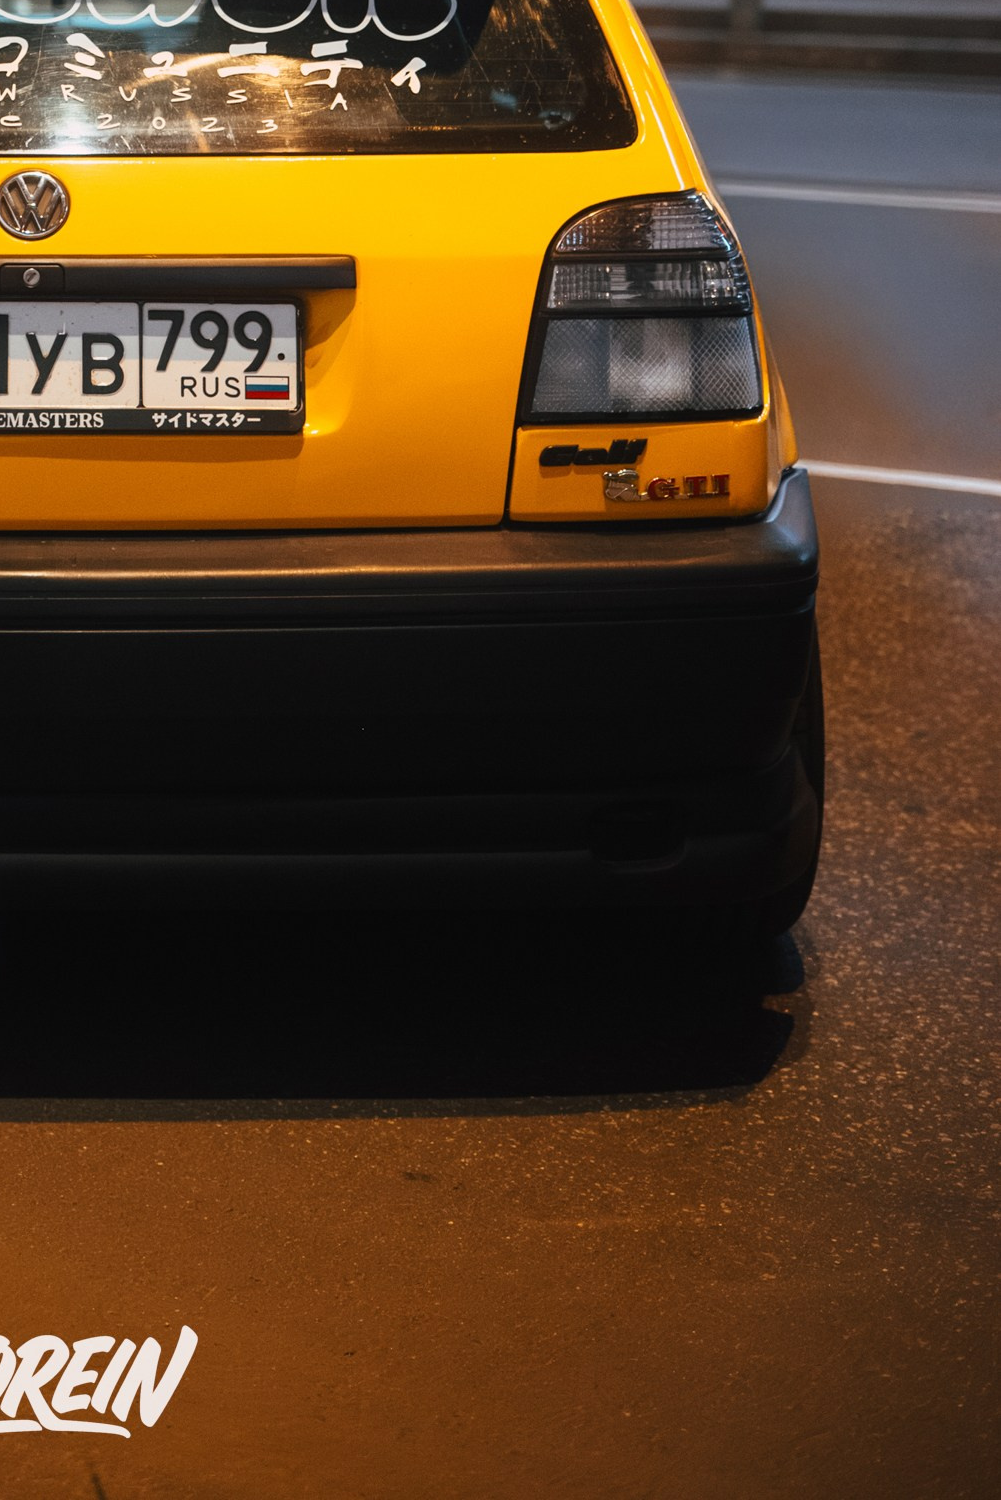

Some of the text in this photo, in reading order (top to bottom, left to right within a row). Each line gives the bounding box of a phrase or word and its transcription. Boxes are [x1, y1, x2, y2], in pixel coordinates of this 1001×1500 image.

[60, 84, 348, 111] RUSSIA
[97, 114, 279, 134] 2023
[147, 309, 273, 373] 799
[180, 376, 241, 398] RUS
[151, 412, 261, 428] サイドマスター
[648, 474, 730, 499] GTI
